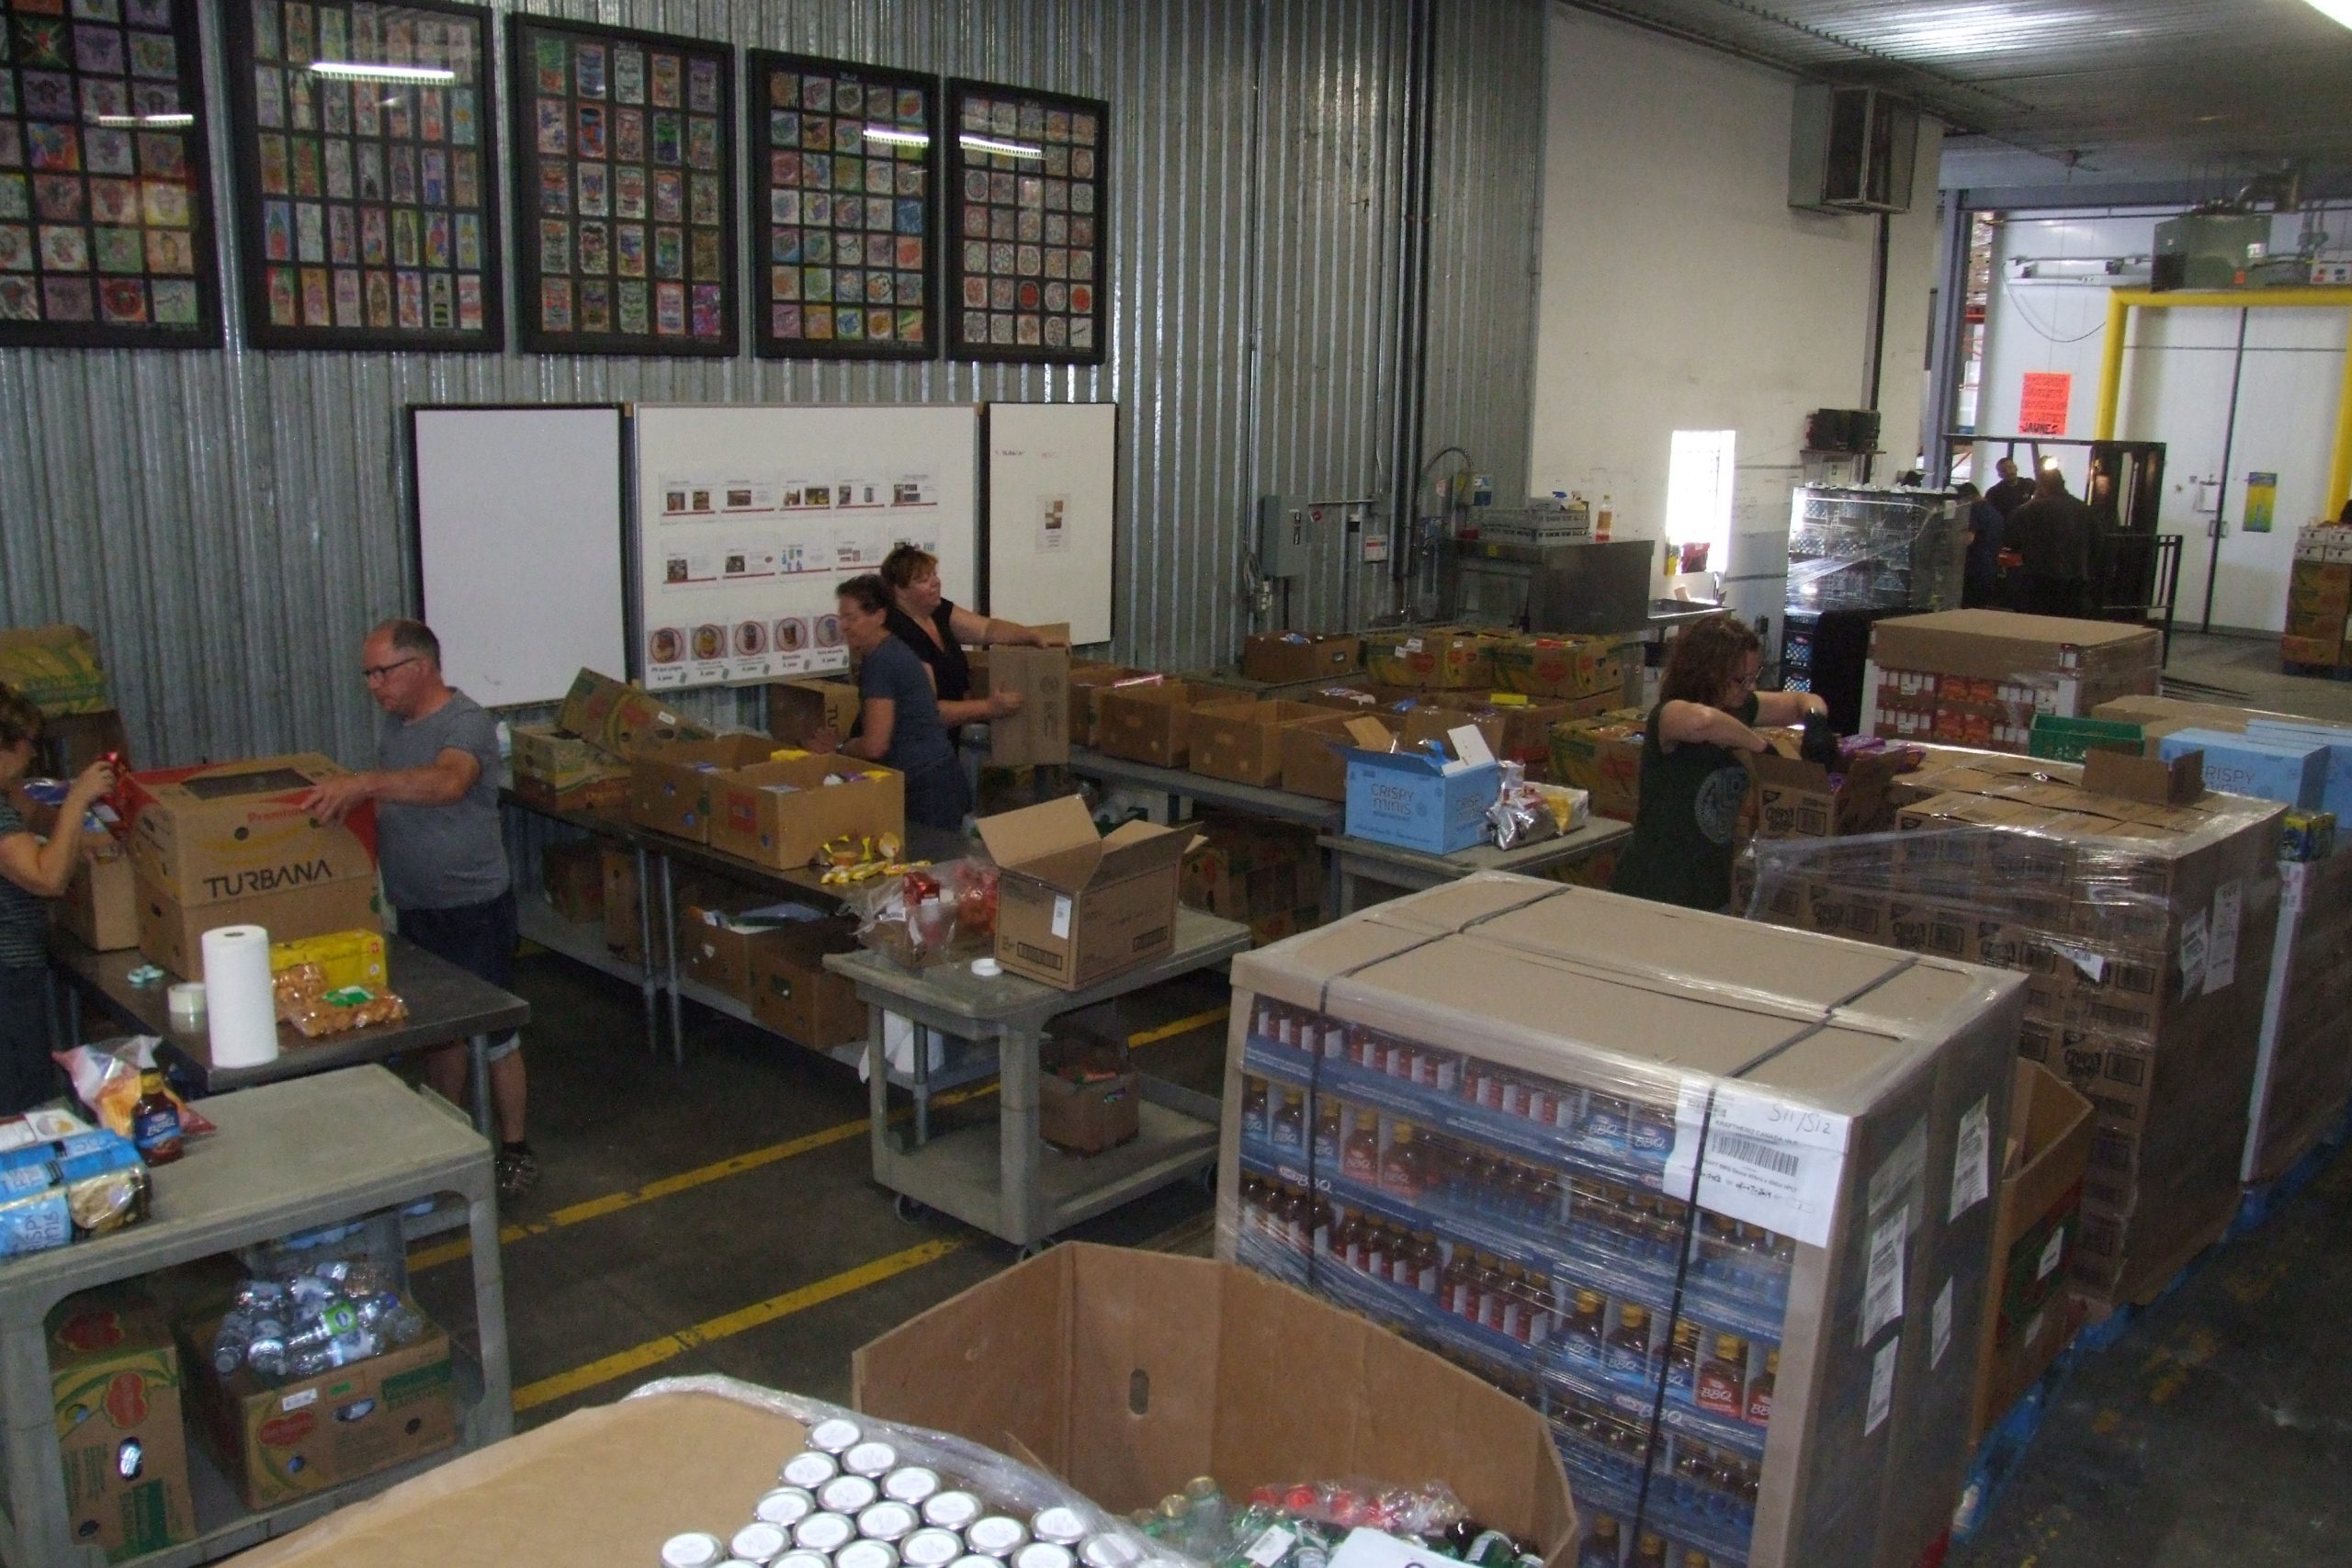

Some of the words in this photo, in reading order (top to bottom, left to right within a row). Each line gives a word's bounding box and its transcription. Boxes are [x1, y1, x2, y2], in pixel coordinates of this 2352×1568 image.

[1371, 783, 1415, 802] CRISPY
[1374, 797, 1412, 817] minis
[202, 859, 333, 898] TURBANA
[1634, 1137, 1668, 1150] BBQ
[1608, 1358, 1638, 1371] BBQ
[1701, 1387, 1734, 1403] BBQ
[1750, 1402, 1771, 1417] BB
